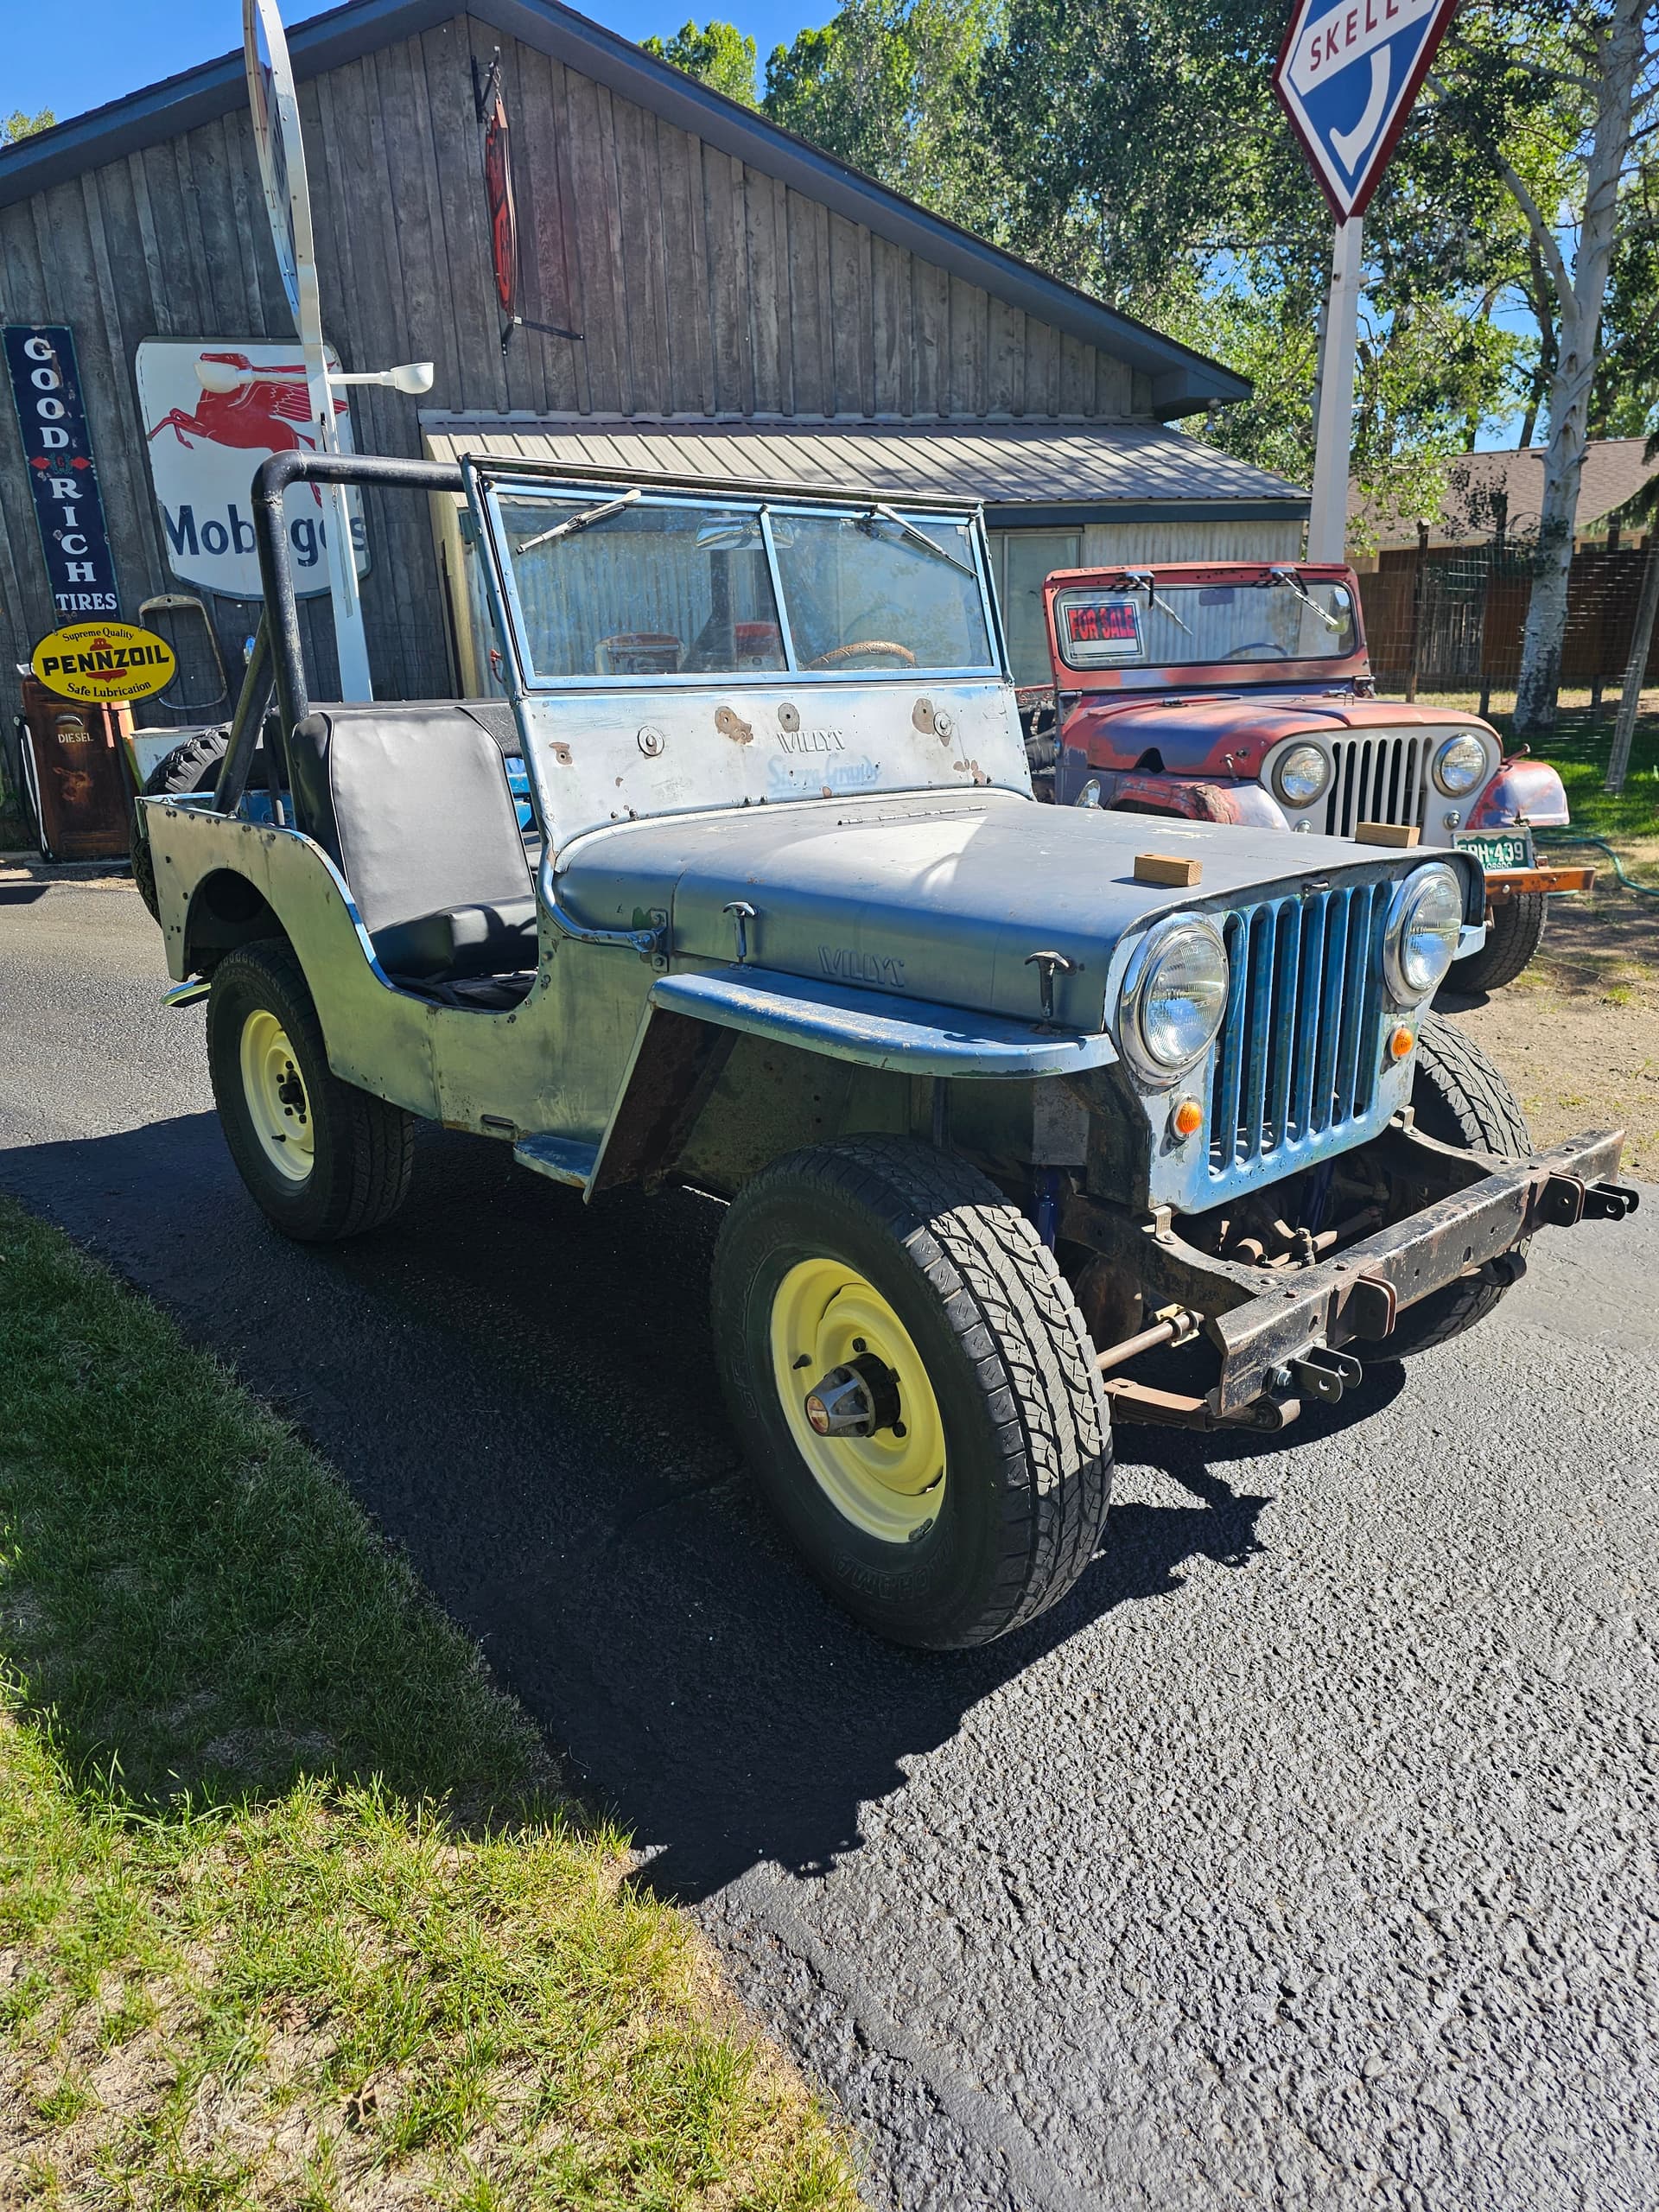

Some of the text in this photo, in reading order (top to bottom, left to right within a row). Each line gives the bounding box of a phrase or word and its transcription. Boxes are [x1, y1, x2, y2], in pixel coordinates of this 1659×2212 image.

[1309, 0, 1415, 72] SKELL
[55, 594, 118, 610] TIRES
[62, 627, 134, 642] Supreme Quality
[1068, 607, 1136, 641] FOR SALE
[41, 645, 170, 677] PENNZOIL
[67, 681, 152, 697] Safe Lubrication
[58, 732, 94, 743] DIESEL
[776, 729, 845, 753] WILLYS
[817, 944, 906, 988] WILLYS
